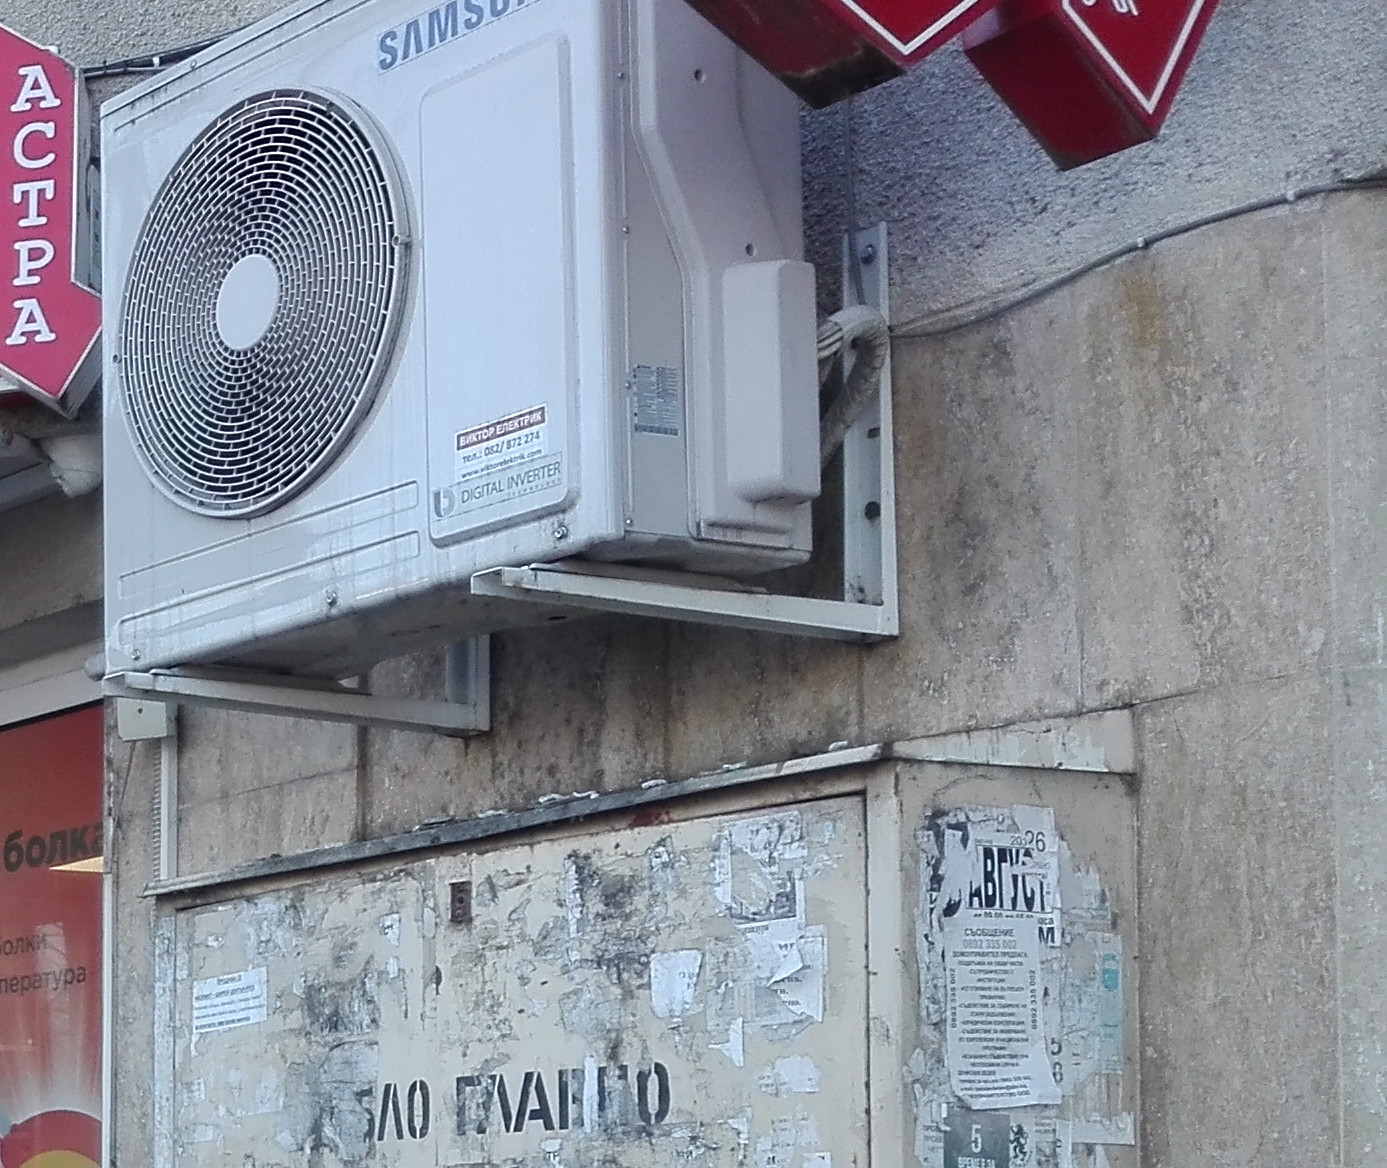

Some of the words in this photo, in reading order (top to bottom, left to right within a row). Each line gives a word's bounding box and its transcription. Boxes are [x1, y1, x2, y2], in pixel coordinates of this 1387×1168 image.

[4, 64, 61, 347] АСТРА
[459, 428, 495, 447] ВИКТОР
[495, 410, 543, 434] ЕЛЕКТРИК
[461, 480, 505, 504] DIGITAL
[507, 461, 561, 490] INVERTER
[971, 1123, 982, 1154] 5
